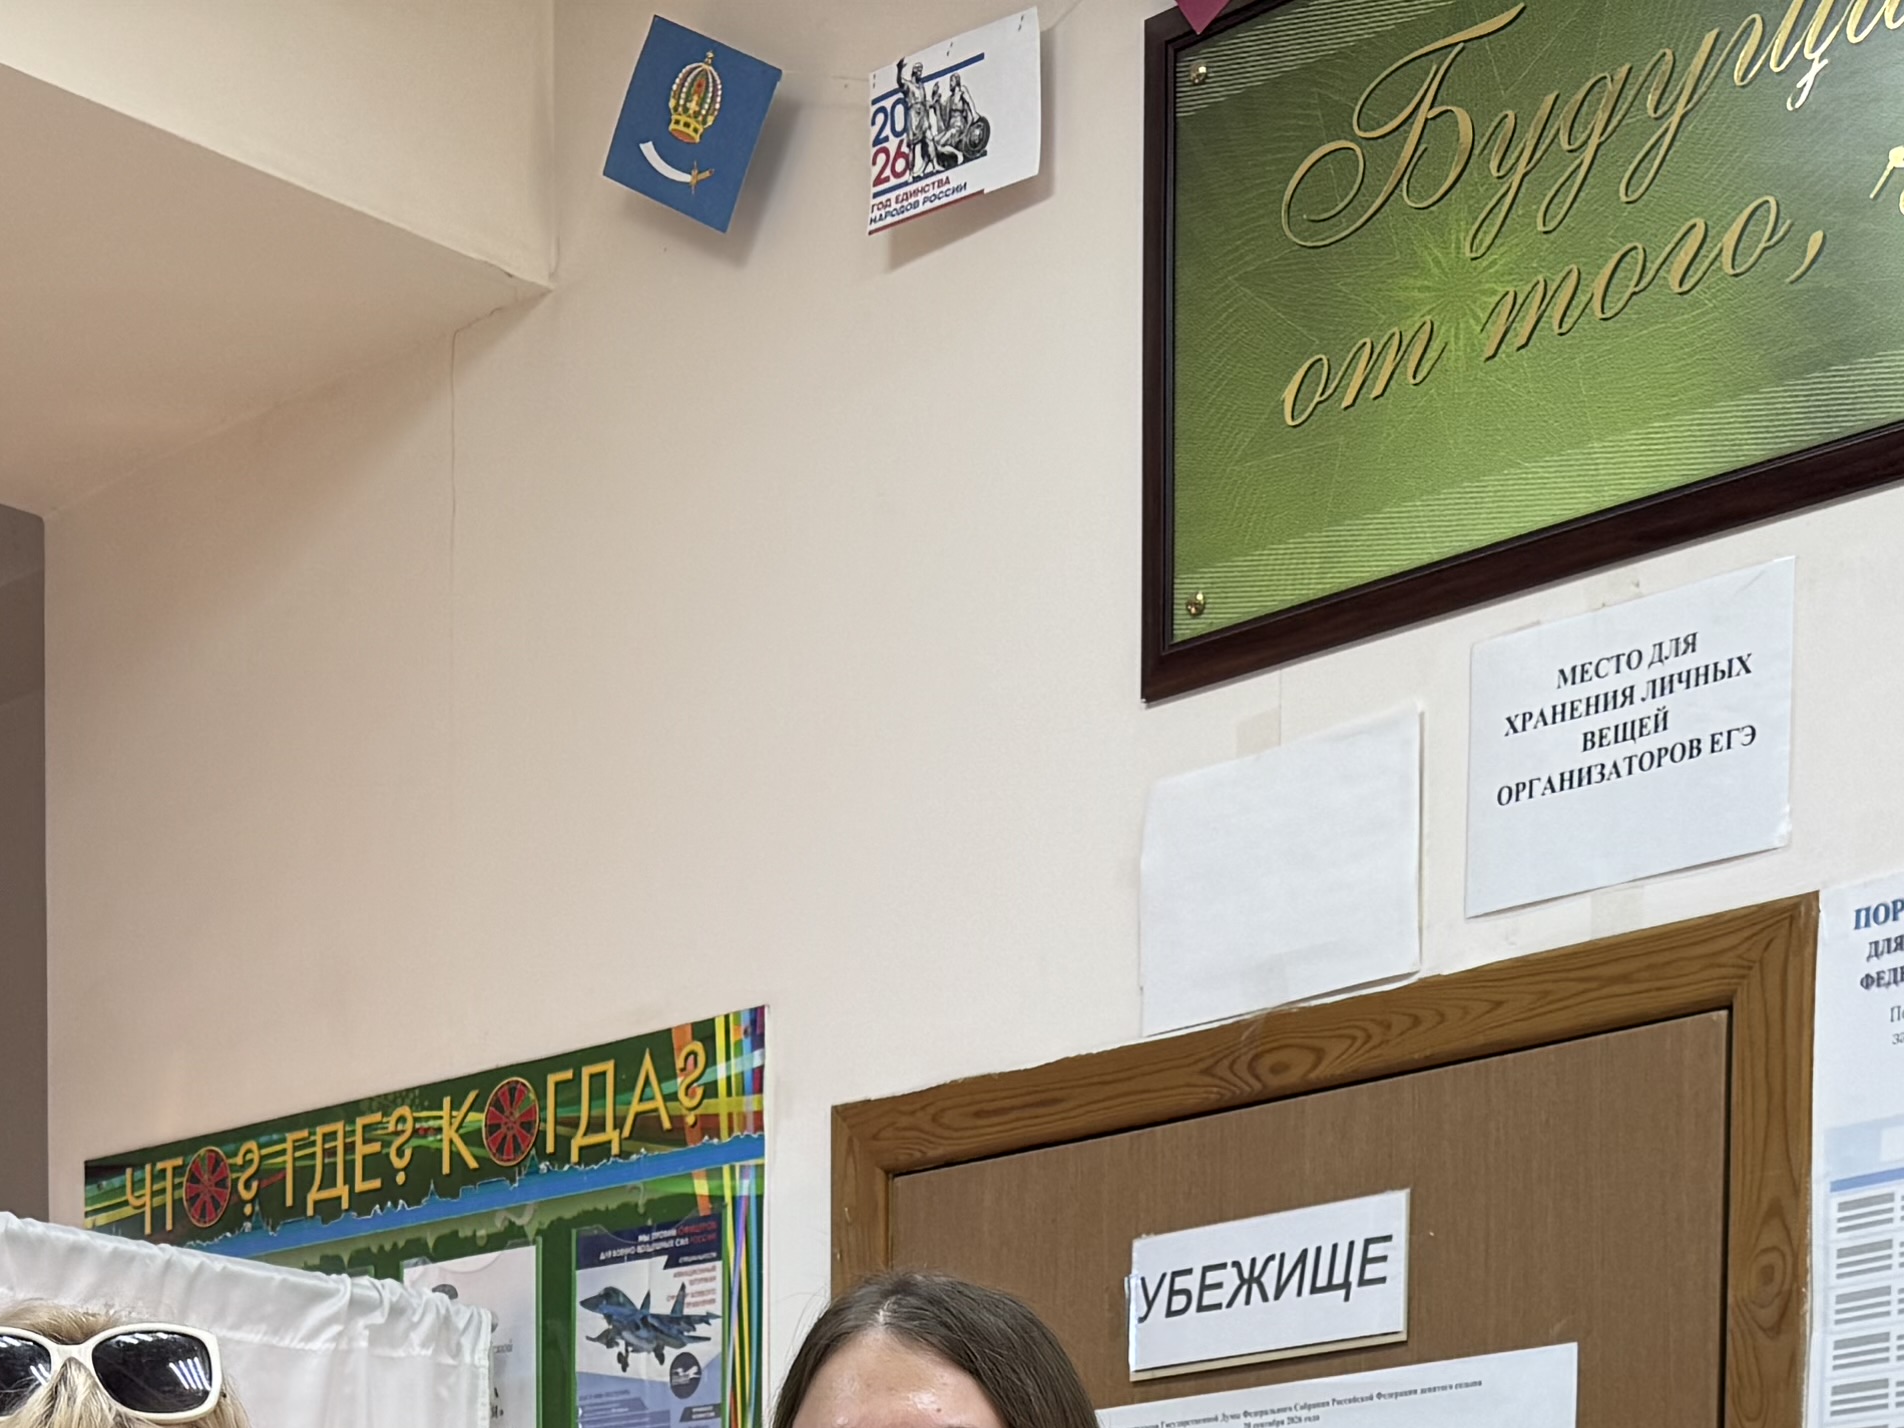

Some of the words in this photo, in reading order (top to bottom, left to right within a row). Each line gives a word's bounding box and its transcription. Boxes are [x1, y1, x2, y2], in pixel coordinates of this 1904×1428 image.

[871, 97, 909, 148] 20
[872, 139, 910, 188] 26
[869, 199, 920, 226] НАРОДОВ
[922, 181, 967, 206] РОССИИ
[871, 198, 892, 214] ГОД
[895, 176, 951, 205] ЕДИНСТВА
[1282, 318, 1446, 427] от
[1480, 195, 1825, 361] того,
[1557, 649, 1643, 690] МЕСТО
[1648, 631, 1699, 671] ДЛЯ
[1504, 684, 1635, 738] ХРАНЕНИЯ
[1640, 653, 1753, 703] ЛИЧНЫХ
[1581, 705, 1670, 753] ВЕЩЕЙ
[1497, 737, 1702, 807] ОРГАНИЗАТОРОВ
[1709, 724, 1757, 755] ЕГЭ
[1865, 934, 1904, 962] ДЛЯ
[285, 1105, 415, 1217] ГДЕ?
[1137, 1234, 1393, 1324] УБЕЖИЩЕ
